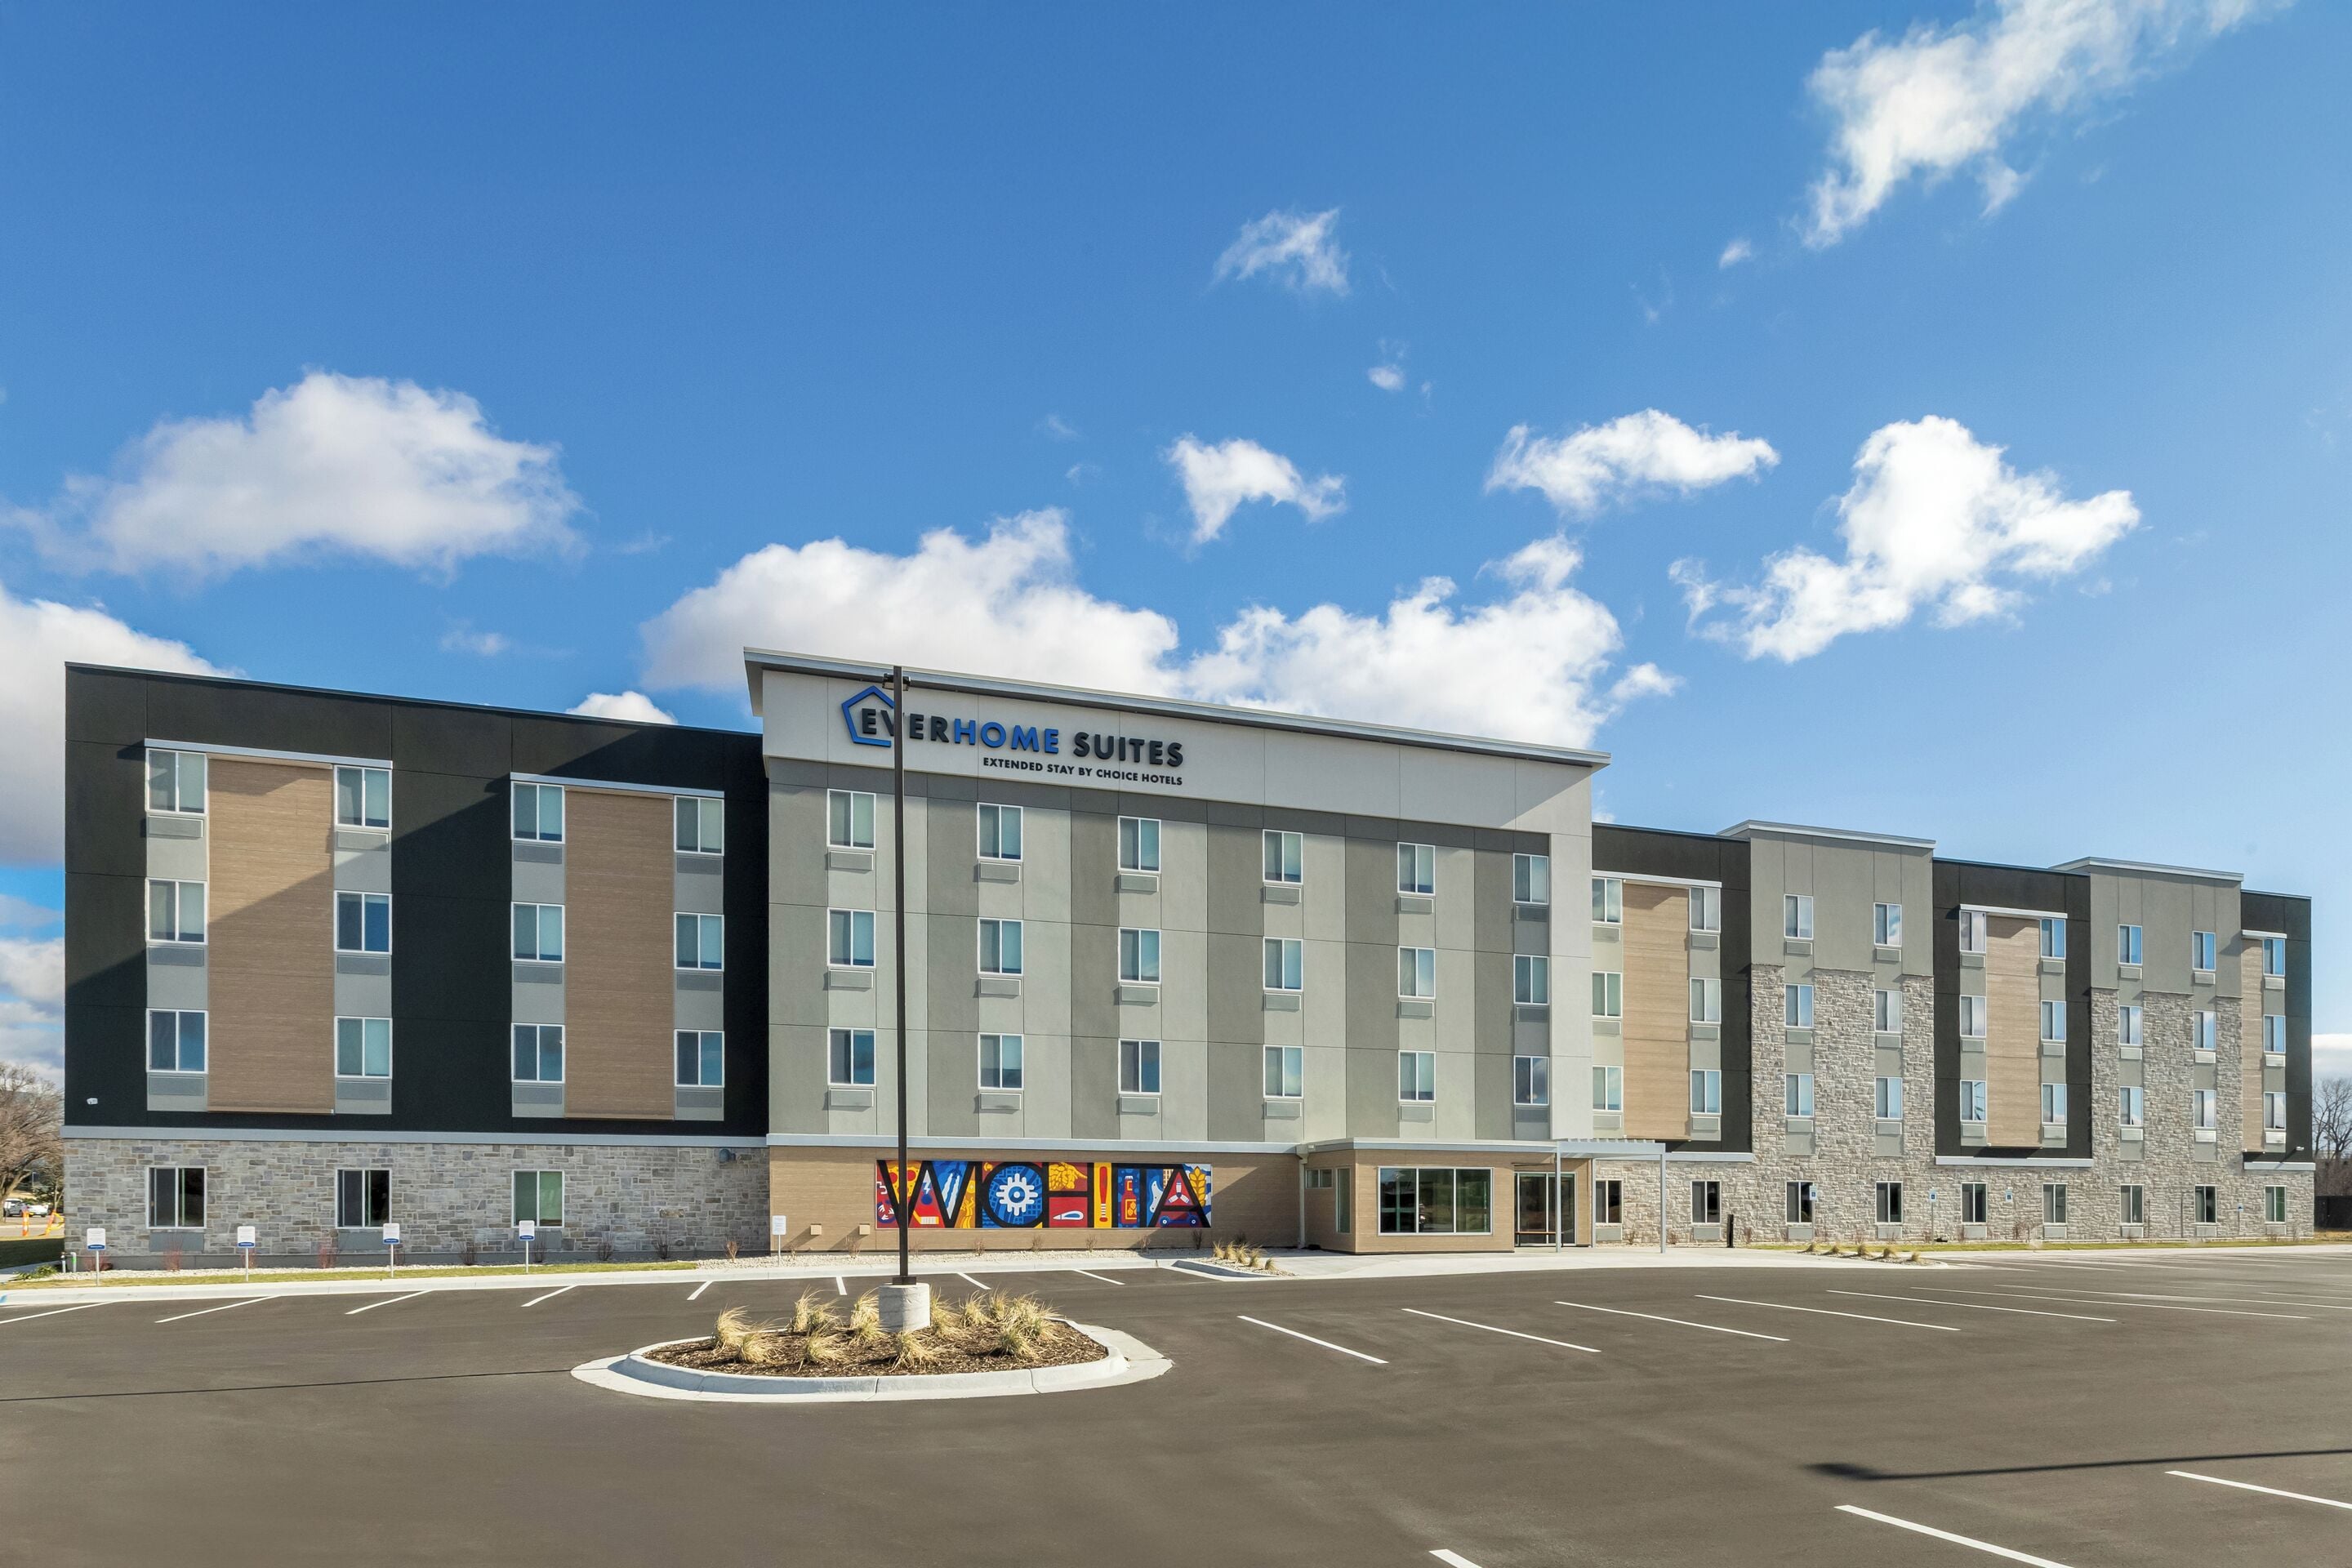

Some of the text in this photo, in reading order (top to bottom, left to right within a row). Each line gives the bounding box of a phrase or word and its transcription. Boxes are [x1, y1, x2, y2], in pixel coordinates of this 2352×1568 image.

[1073, 731, 1184, 768] SUITES
[982, 757, 1183, 786] EXTENDED STAY BY CHOICE HOTELS
